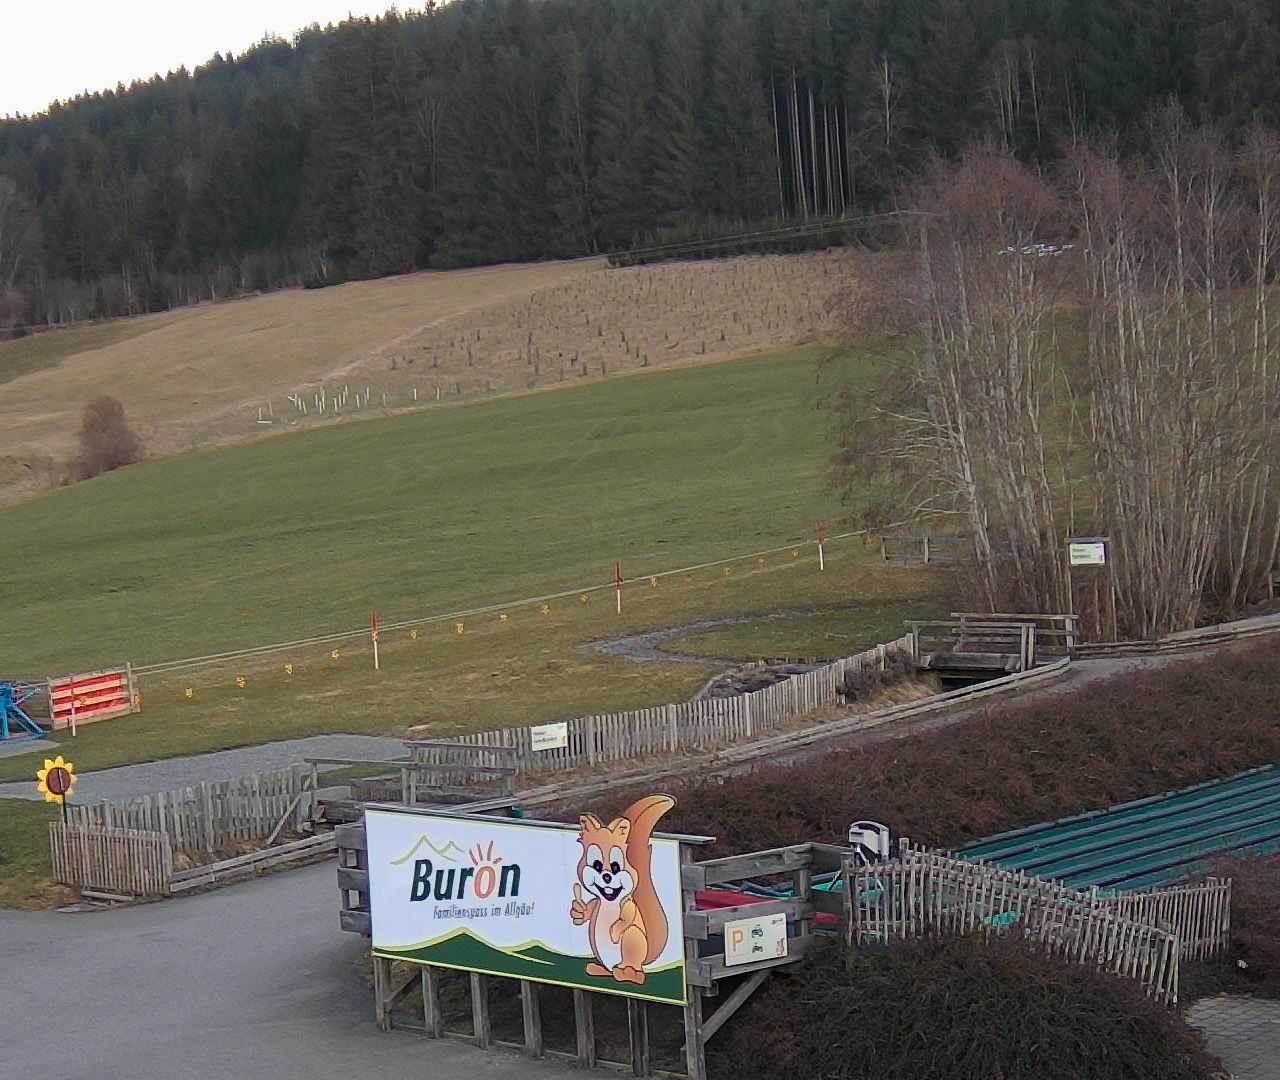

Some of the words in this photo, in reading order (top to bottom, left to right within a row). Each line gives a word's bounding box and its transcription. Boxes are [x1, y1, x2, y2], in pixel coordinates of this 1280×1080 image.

[410, 858, 521, 902] Buron
[491, 903, 501, 916] im
[732, 929, 744, 952] P
